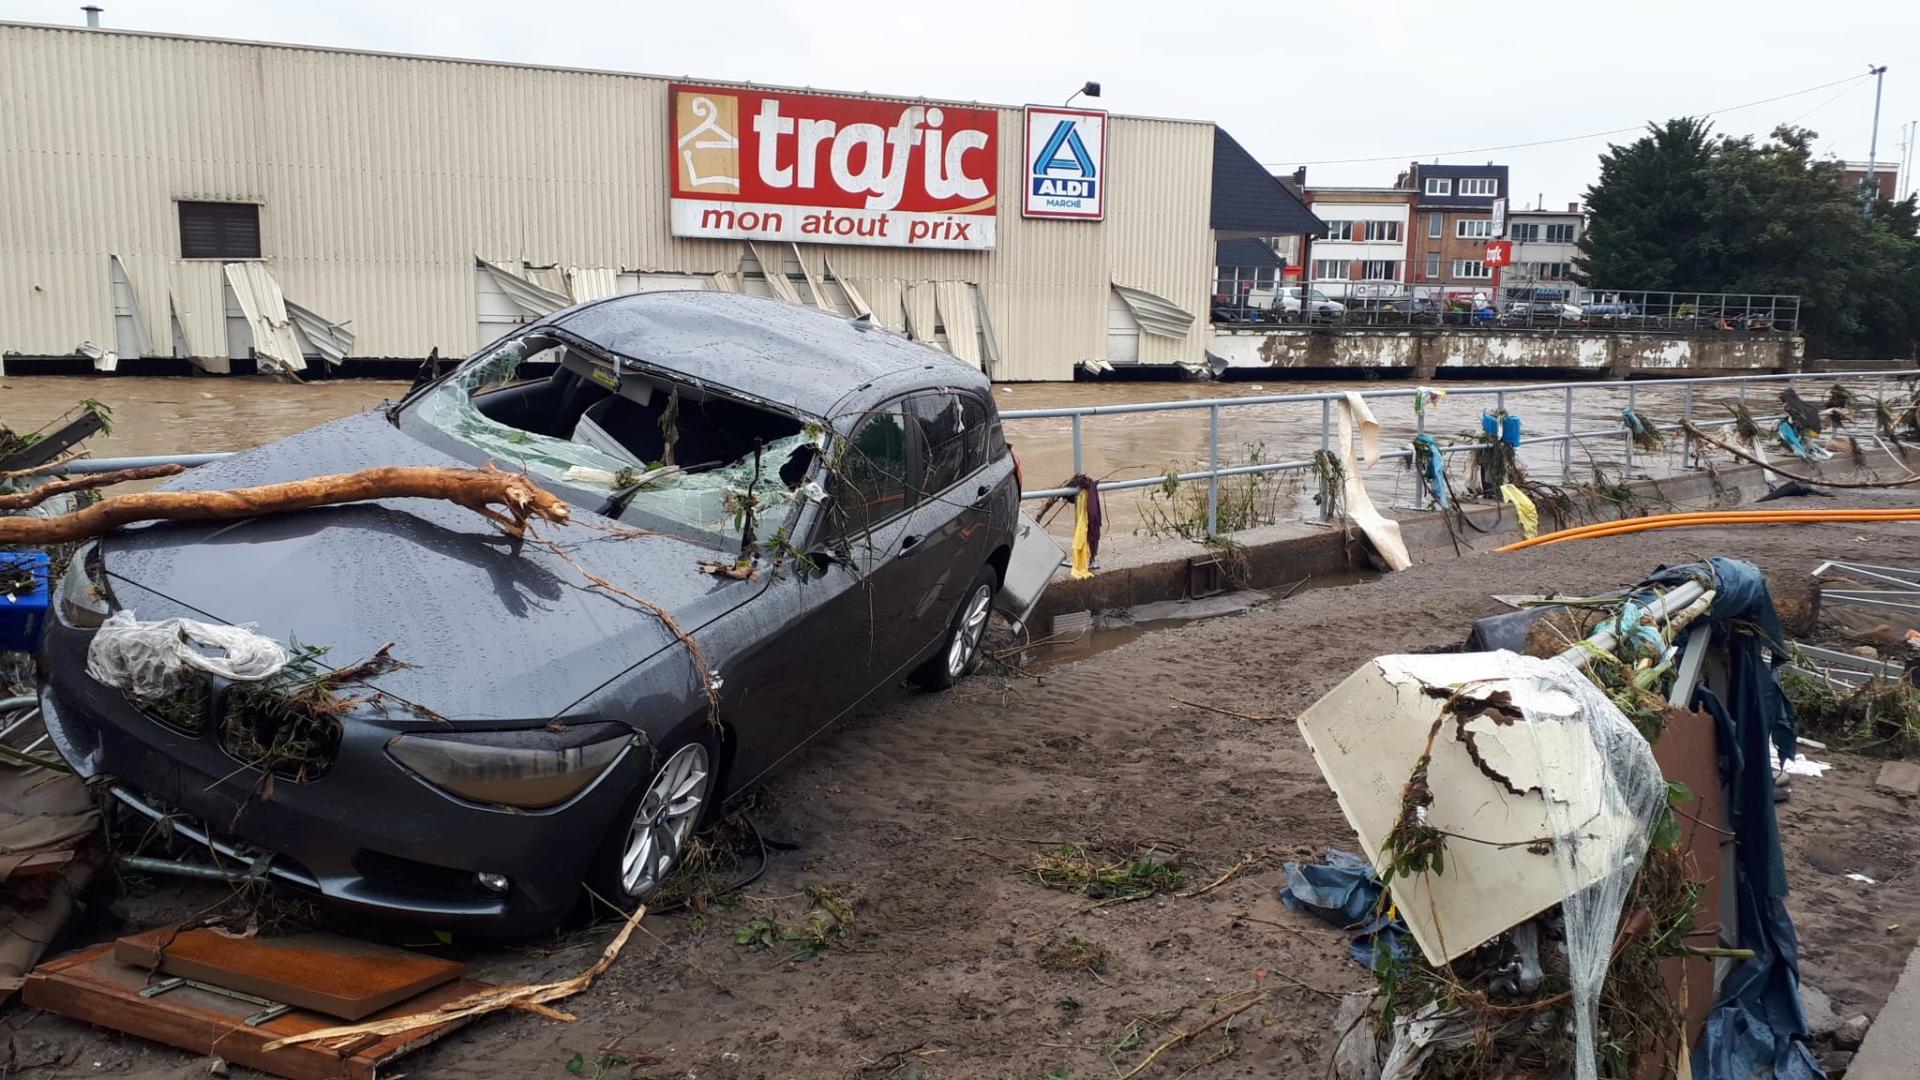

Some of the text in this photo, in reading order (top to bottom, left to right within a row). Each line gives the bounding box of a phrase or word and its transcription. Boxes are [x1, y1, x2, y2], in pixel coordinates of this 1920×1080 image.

[753, 98, 990, 211] trafic
[1037, 179, 1089, 197] ALDI
[1046, 199, 1082, 208] MARCHÉ
[701, 209, 972, 244] mon atout prix
